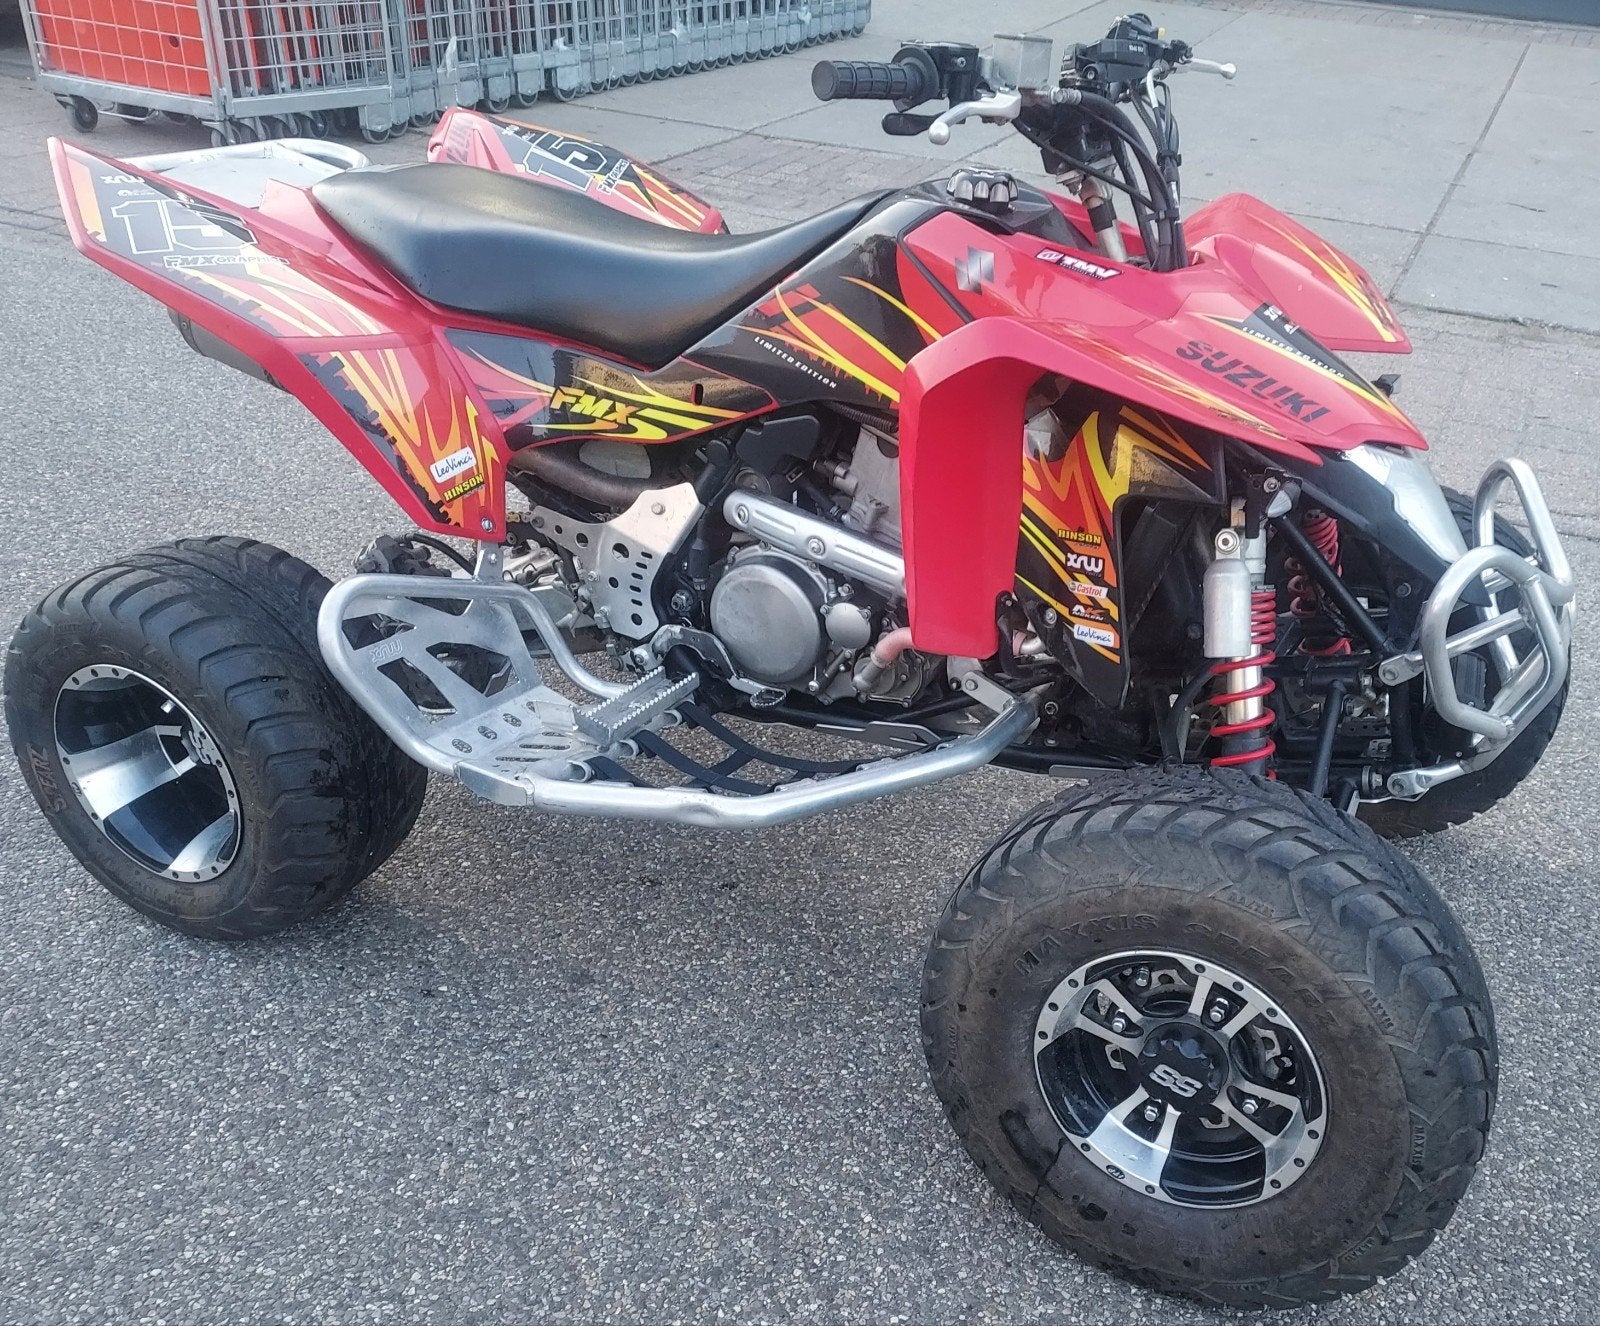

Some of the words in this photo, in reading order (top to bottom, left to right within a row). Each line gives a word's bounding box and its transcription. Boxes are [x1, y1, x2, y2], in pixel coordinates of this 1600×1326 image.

[1062, 255, 1121, 279] TMV
[754, 336, 796, 363] LIMITED
[794, 361, 837, 389] EDITION
[1175, 340, 1332, 423] SUZUKI
[550, 385, 640, 427] FMX
[434, 451, 473, 478] LeoVinci
[443, 474, 484, 501] HINSON
[1057, 529, 1102, 544] HINSON
[1076, 584, 1103, 597] Castrol
[1076, 626, 1112, 643] LeoVinci
[1012, 913, 1160, 978] MAXXIS
[1148, 1063, 1204, 1098] SS
[1410, 1125, 1426, 1167] MAXXIS
